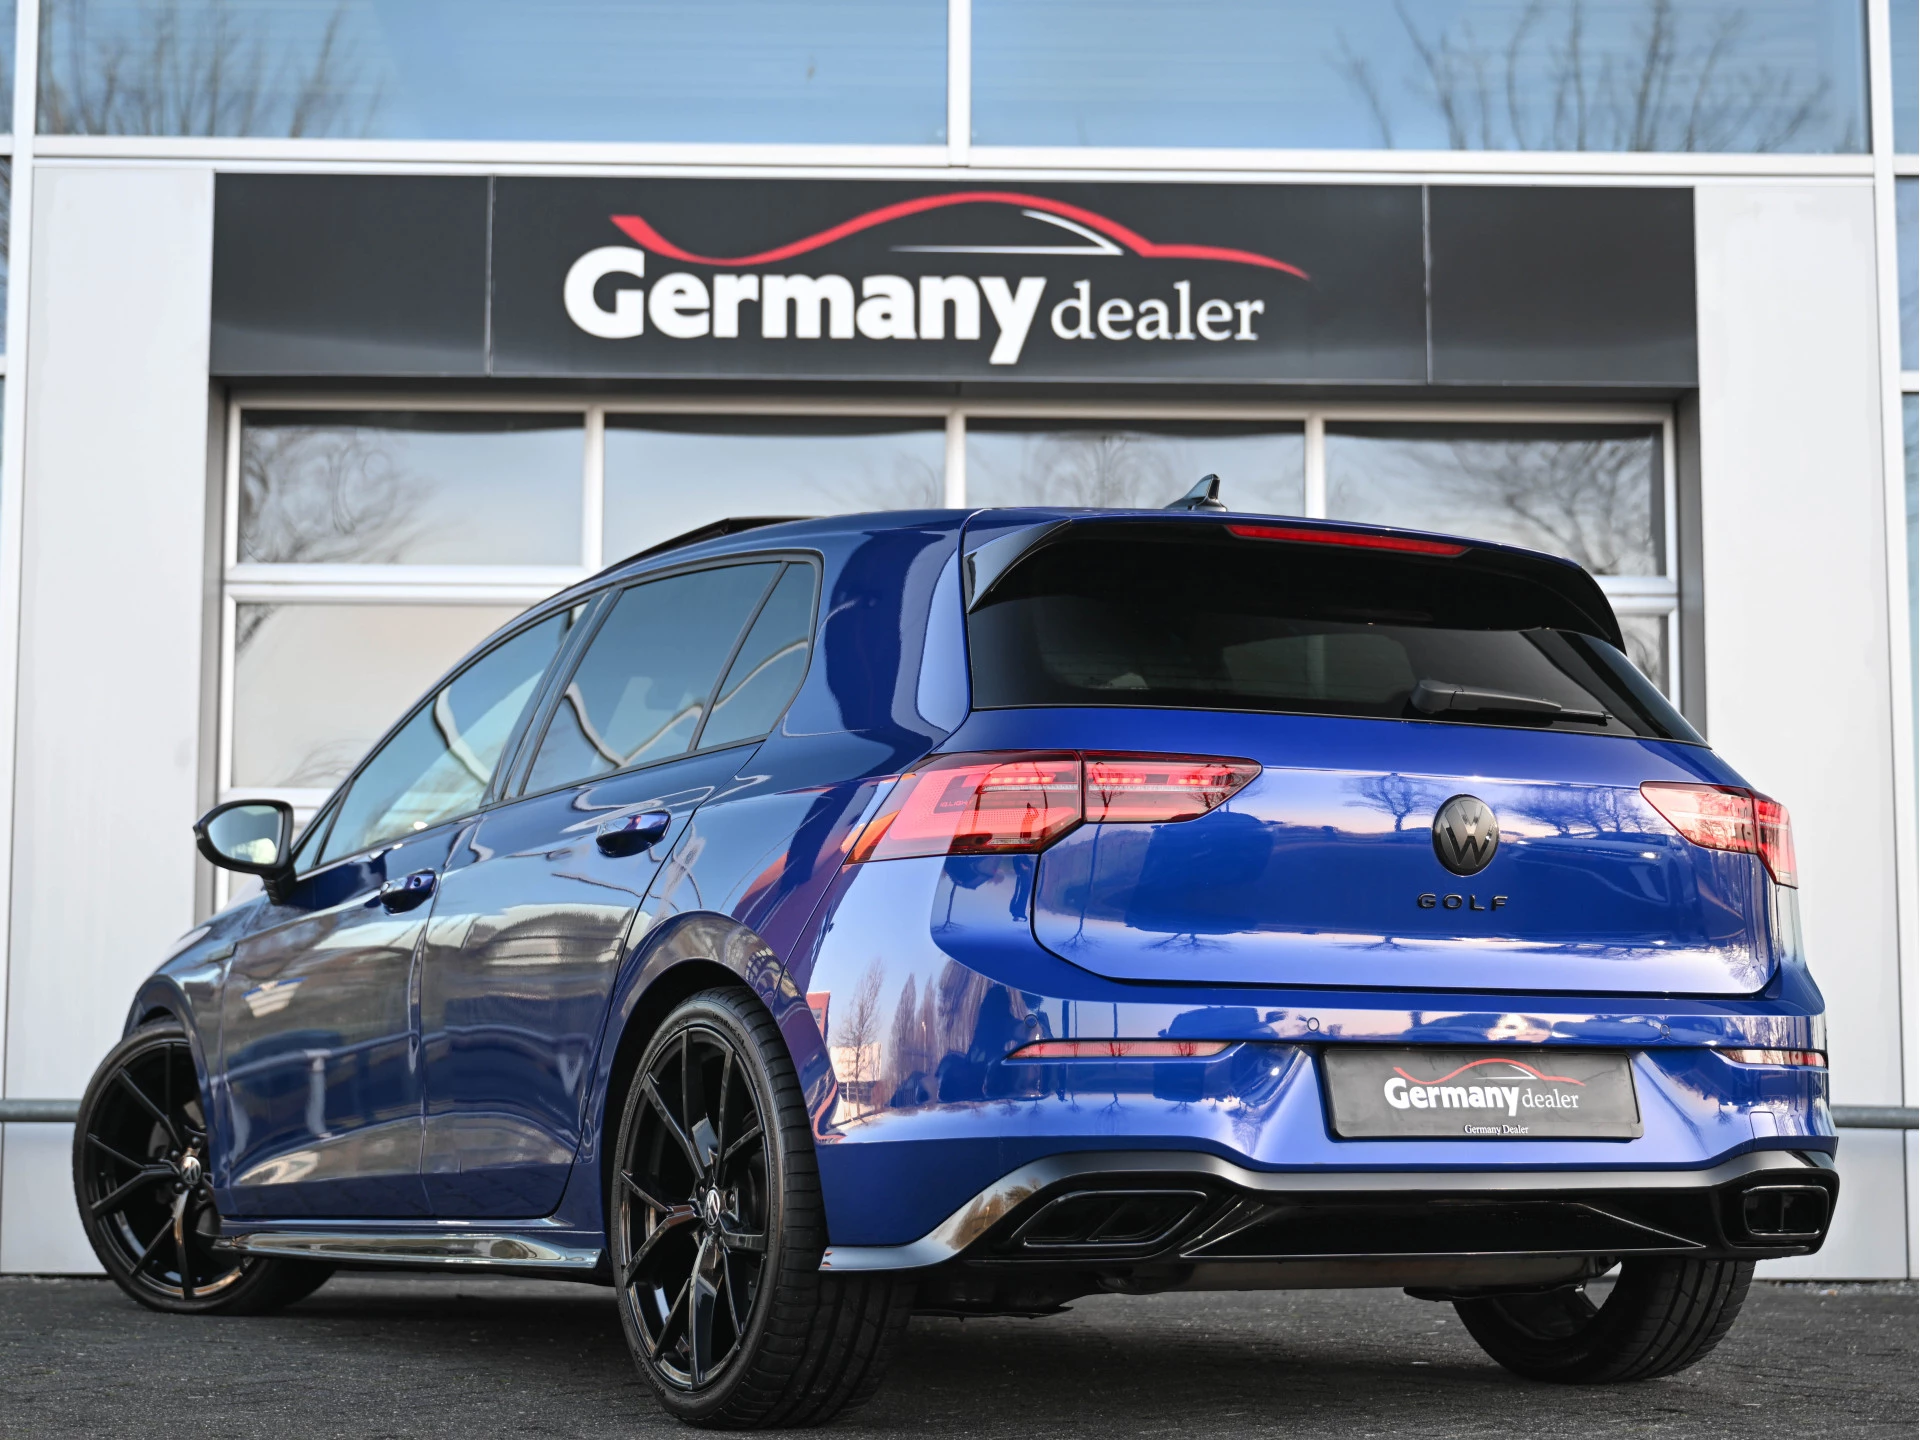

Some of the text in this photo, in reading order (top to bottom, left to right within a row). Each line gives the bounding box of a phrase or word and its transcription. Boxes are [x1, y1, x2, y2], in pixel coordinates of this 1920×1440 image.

[564, 246, 1265, 365] Germany dealer
[1417, 893, 1508, 911] GOLF
[1383, 1077, 1580, 1117] Germany dealer
[1464, 1124, 1529, 1136] Germany Dealer
